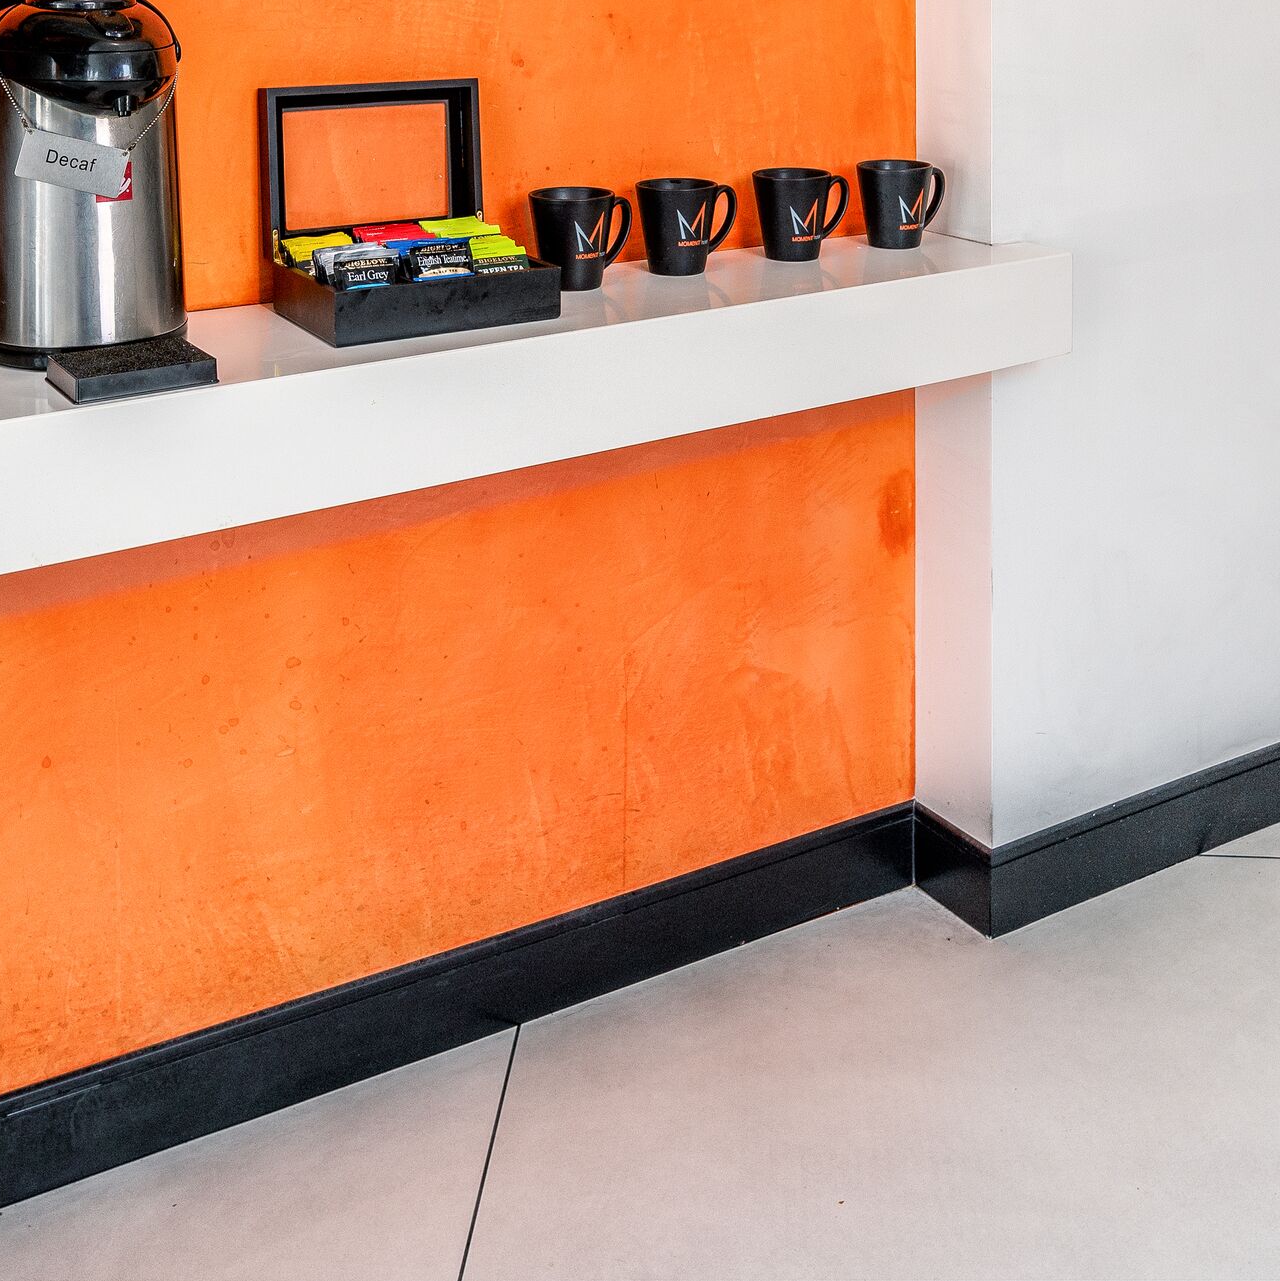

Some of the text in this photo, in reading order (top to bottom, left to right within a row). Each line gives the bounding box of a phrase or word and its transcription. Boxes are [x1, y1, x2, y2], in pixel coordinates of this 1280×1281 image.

[46, 148, 97, 172] Decaf
[416, 254, 442, 268] English
[347, 269, 389, 282] Earl Grey
